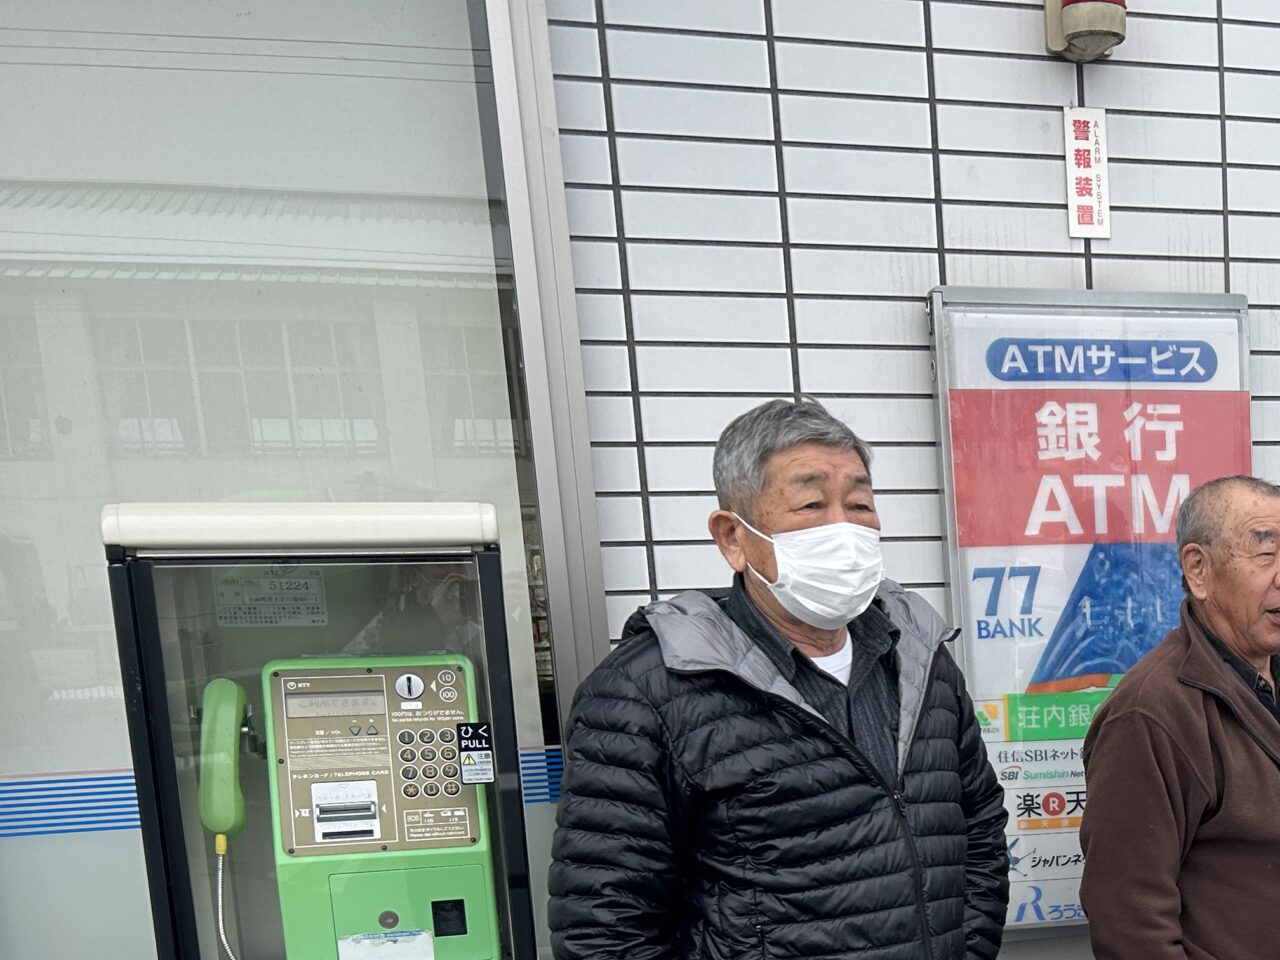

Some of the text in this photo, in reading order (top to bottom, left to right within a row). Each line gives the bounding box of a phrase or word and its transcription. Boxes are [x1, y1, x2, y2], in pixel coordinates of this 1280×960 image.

[1072, 119, 1095, 226] 警報装置
[1093, 121, 1104, 226] ALARM SYSTEM
[1000, 344, 1207, 377] ATMサービス
[1024, 474, 1190, 536] ATM
[269, 581, 311, 591] 51224
[972, 566, 1042, 617] 77
[976, 618, 1045, 640] BANK
[1018, 703, 1101, 728] 荘内銀
[460, 725, 489, 738] ひく
[461, 739, 490, 749] PULL
[1000, 770, 1019, 781] SBI
[1023, 769, 1069, 780] Sumishin
